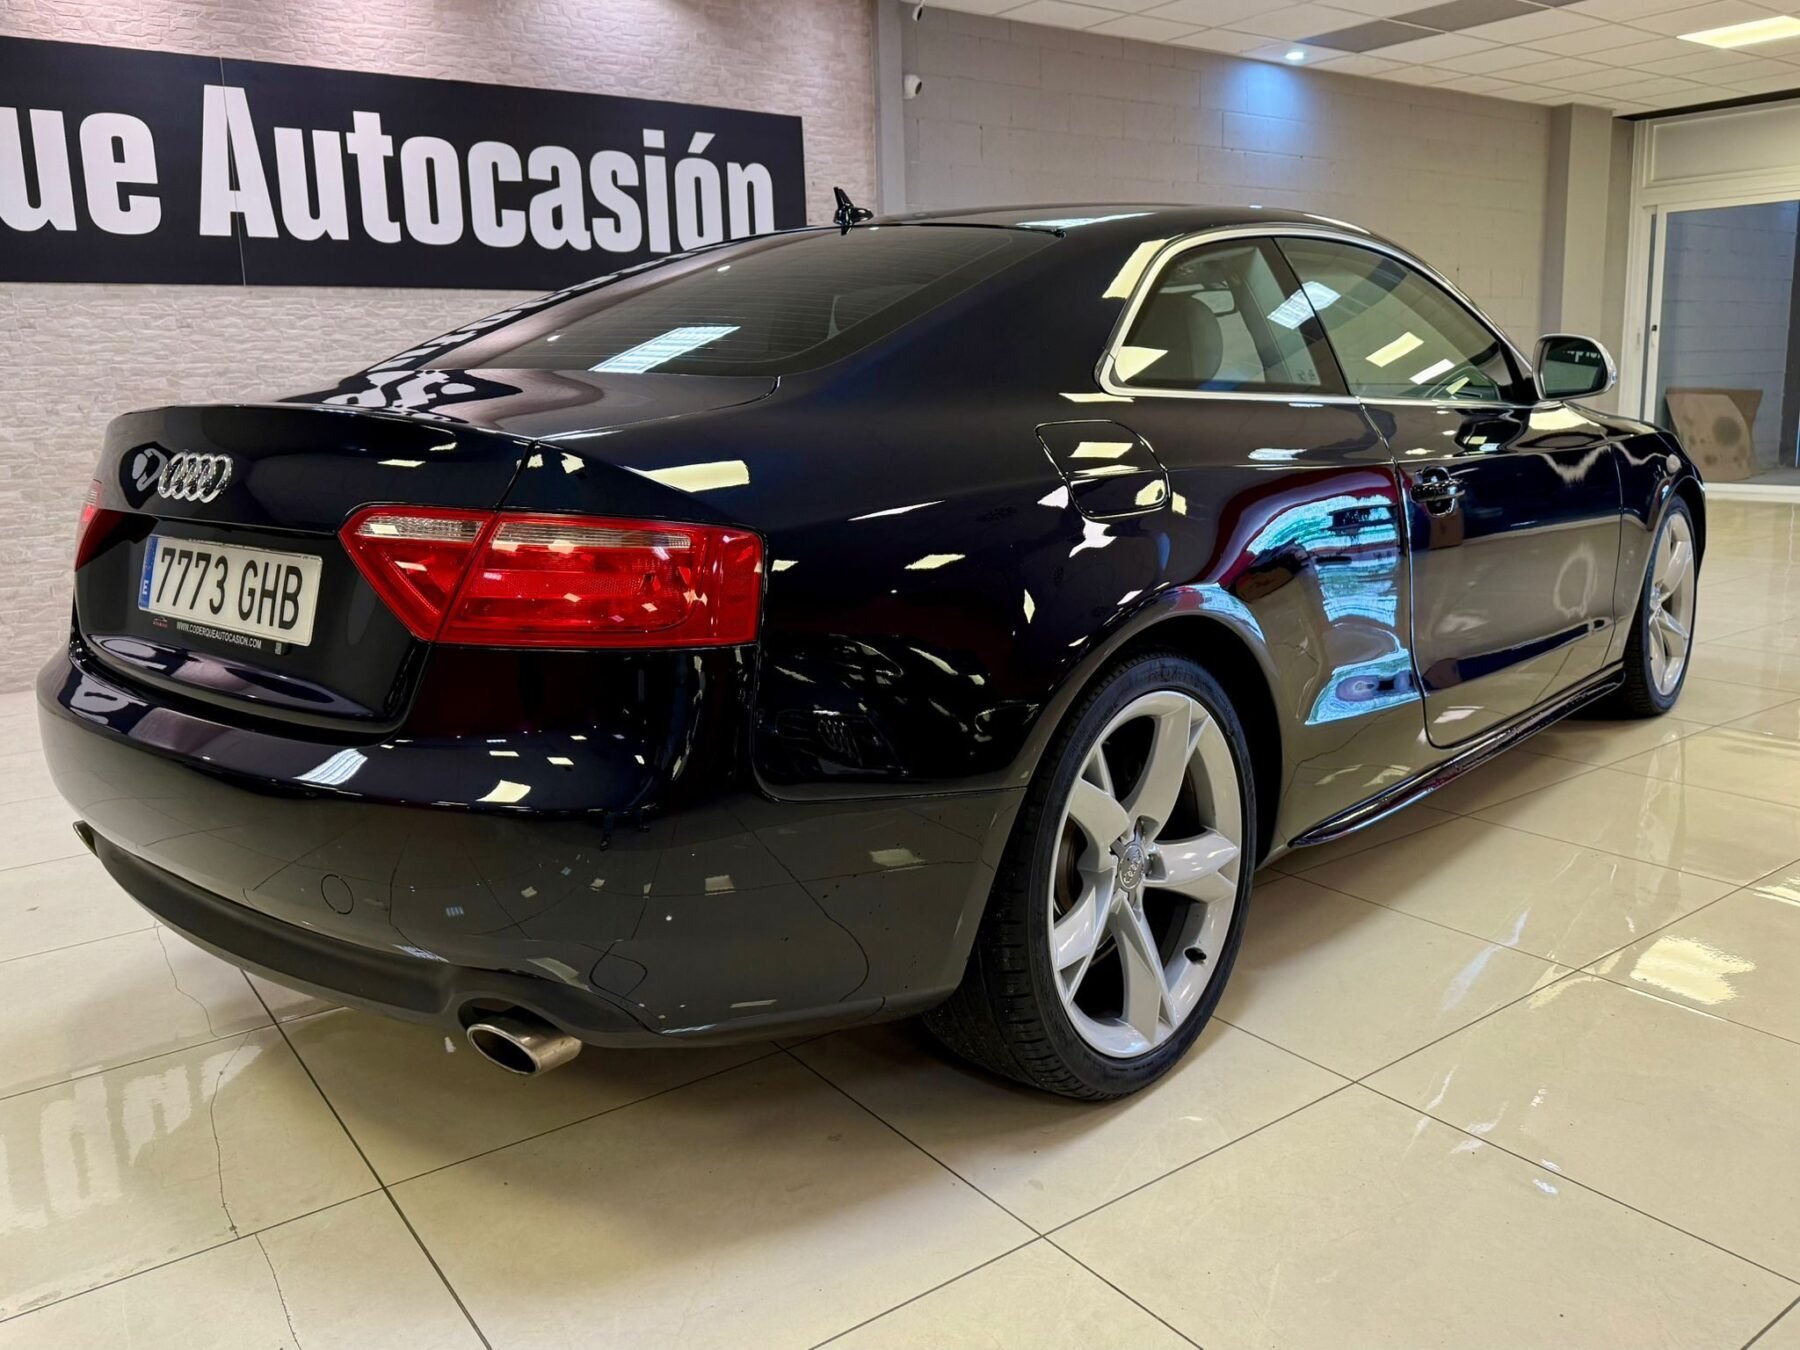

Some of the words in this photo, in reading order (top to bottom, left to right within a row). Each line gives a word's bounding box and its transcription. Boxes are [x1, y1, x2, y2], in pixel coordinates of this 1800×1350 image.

[200, 84, 775, 253] Autocasión
[156, 547, 229, 615] 7773
[238, 560, 303, 630] GHB
